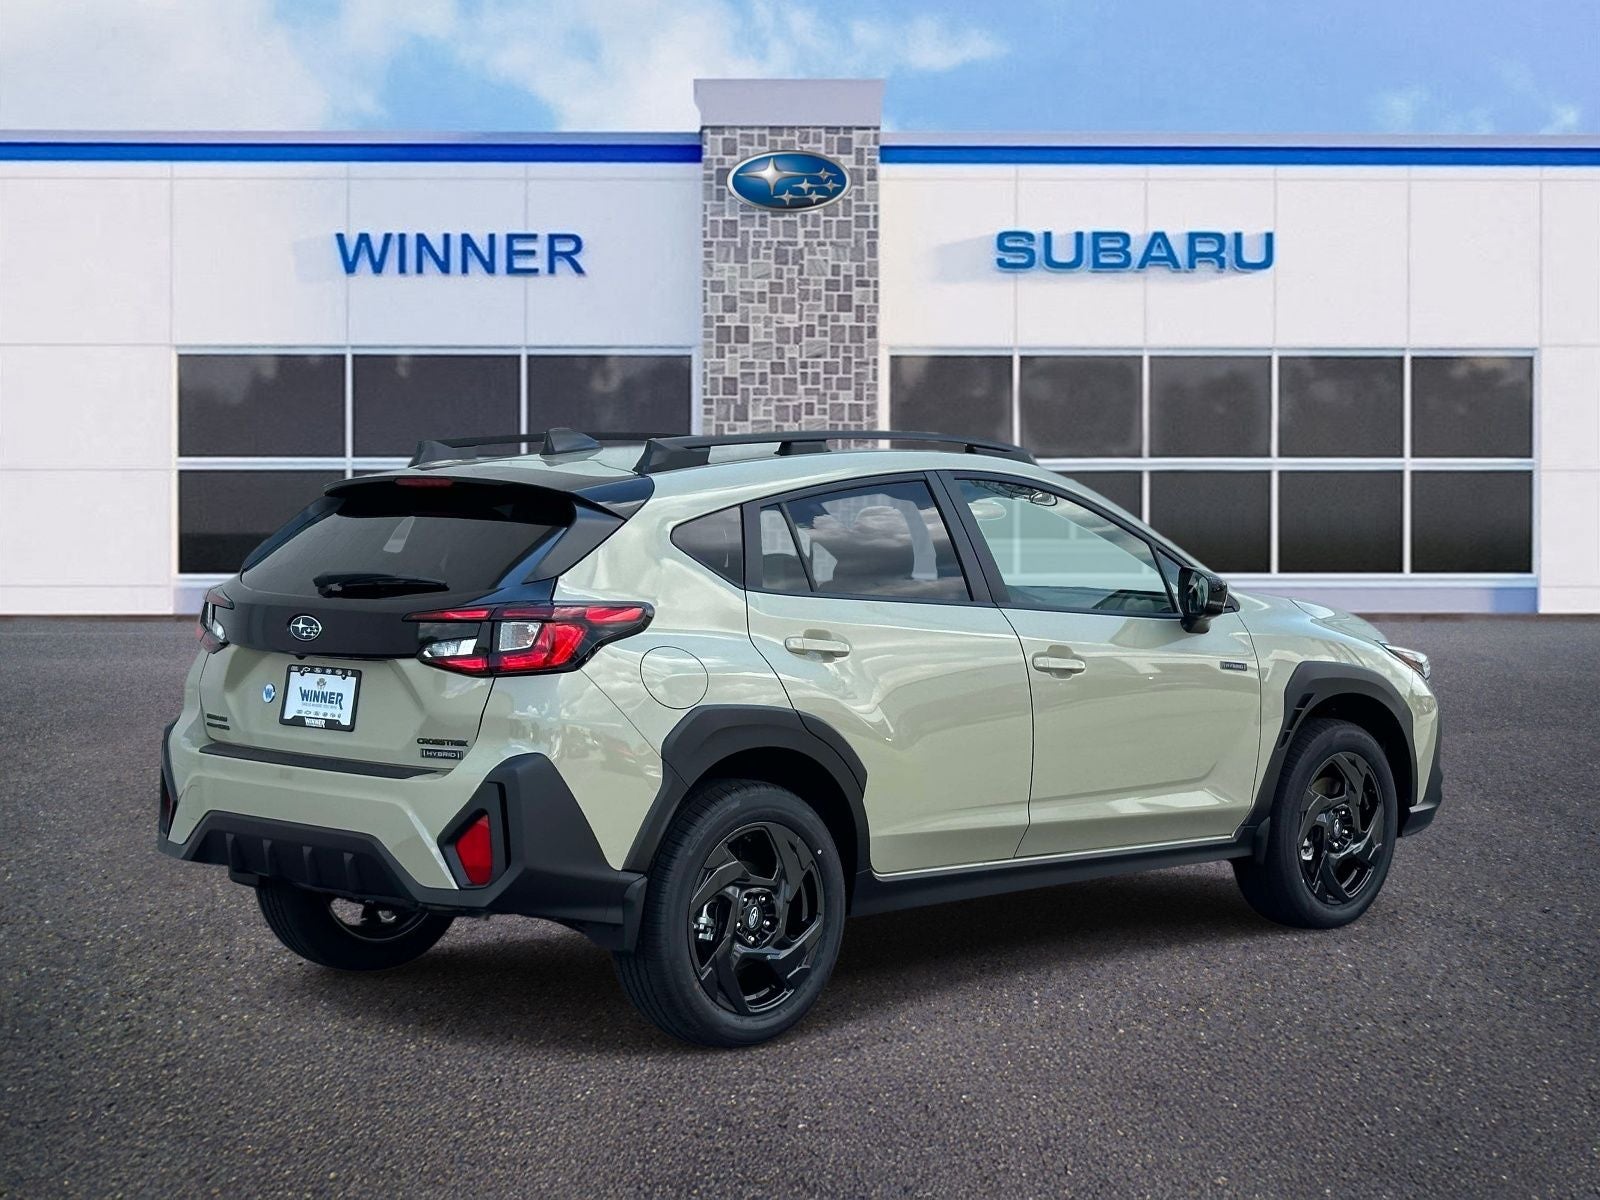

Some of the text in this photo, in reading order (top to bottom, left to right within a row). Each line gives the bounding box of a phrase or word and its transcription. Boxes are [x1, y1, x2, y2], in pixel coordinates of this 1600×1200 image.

[335, 232, 585, 275] WINNER
[996, 230, 1274, 271] SUBARU
[299, 686, 343, 710] WINNER
